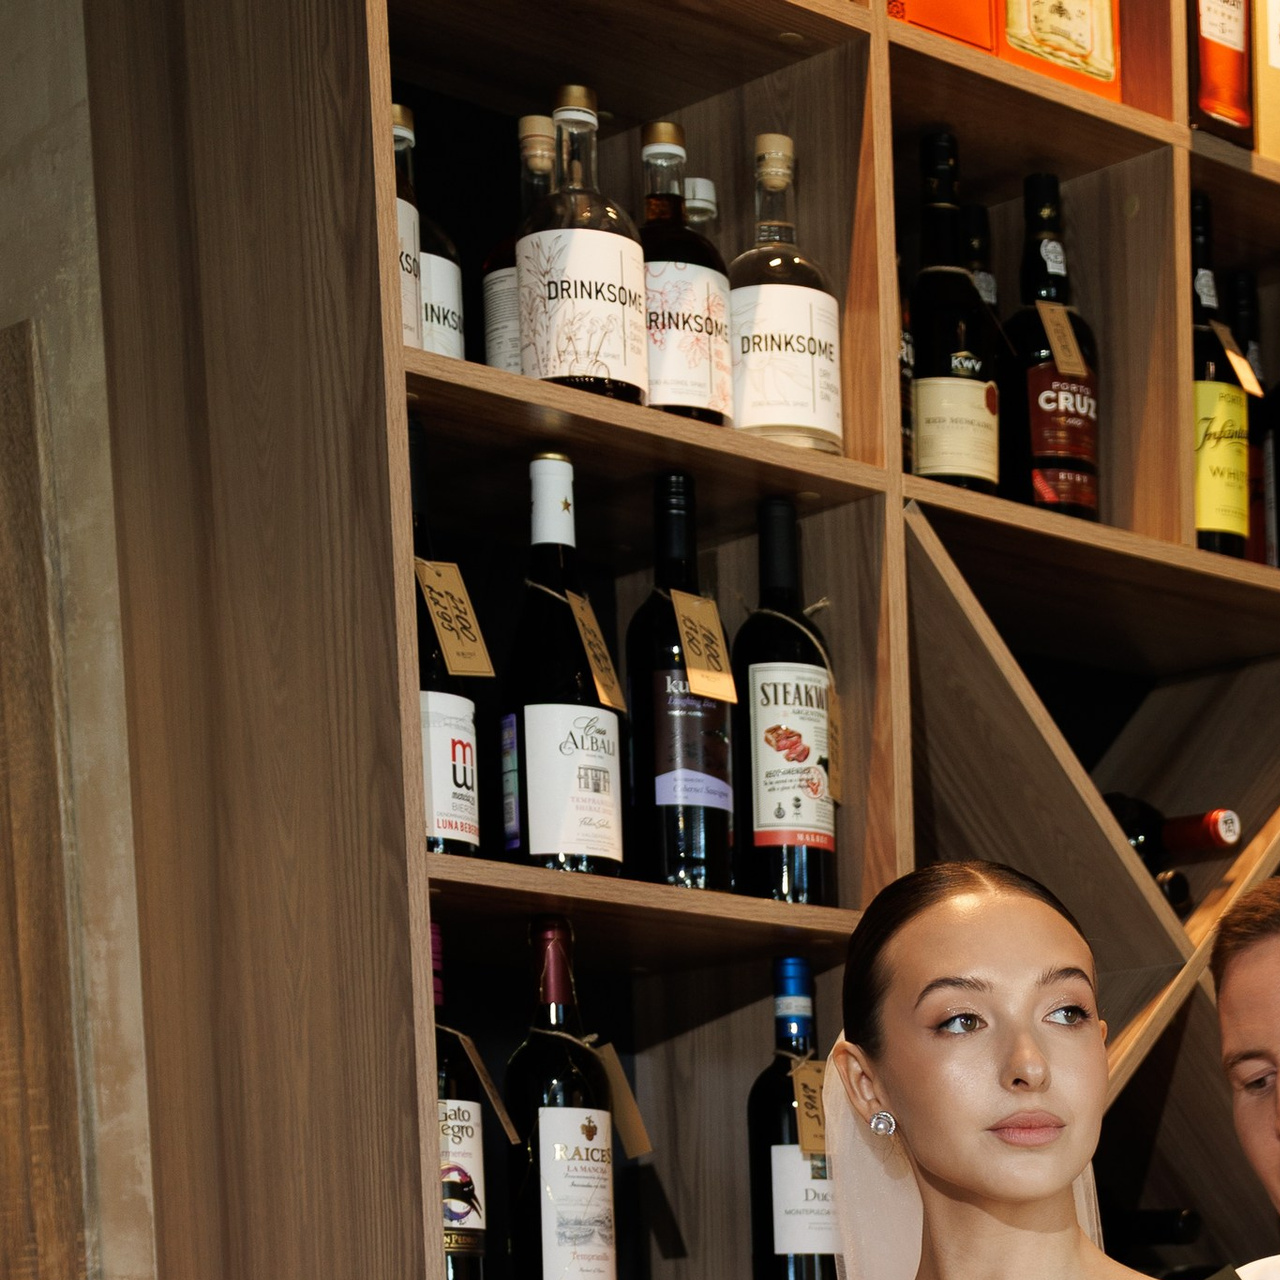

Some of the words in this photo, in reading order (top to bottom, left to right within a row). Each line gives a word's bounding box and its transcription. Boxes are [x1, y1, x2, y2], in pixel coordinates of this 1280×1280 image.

[547, 280, 644, 315] DRINKSOME
[647, 311, 729, 345] RINKSOME
[741, 334, 835, 363] DRINKSOME
[951, 356, 982, 373] KWV
[1051, 381, 1091, 396] PORTO
[1038, 390, 1098, 421] CRUZ
[1209, 465, 1247, 481] WHIT
[447, 590, 478, 643] 2700
[698, 622, 723, 674] 1600
[559, 730, 615, 757] ALBALI
[436, 818, 459, 831] LUNA
[801, 1082, 822, 1127] 2465
[441, 1123, 475, 1145] egro
